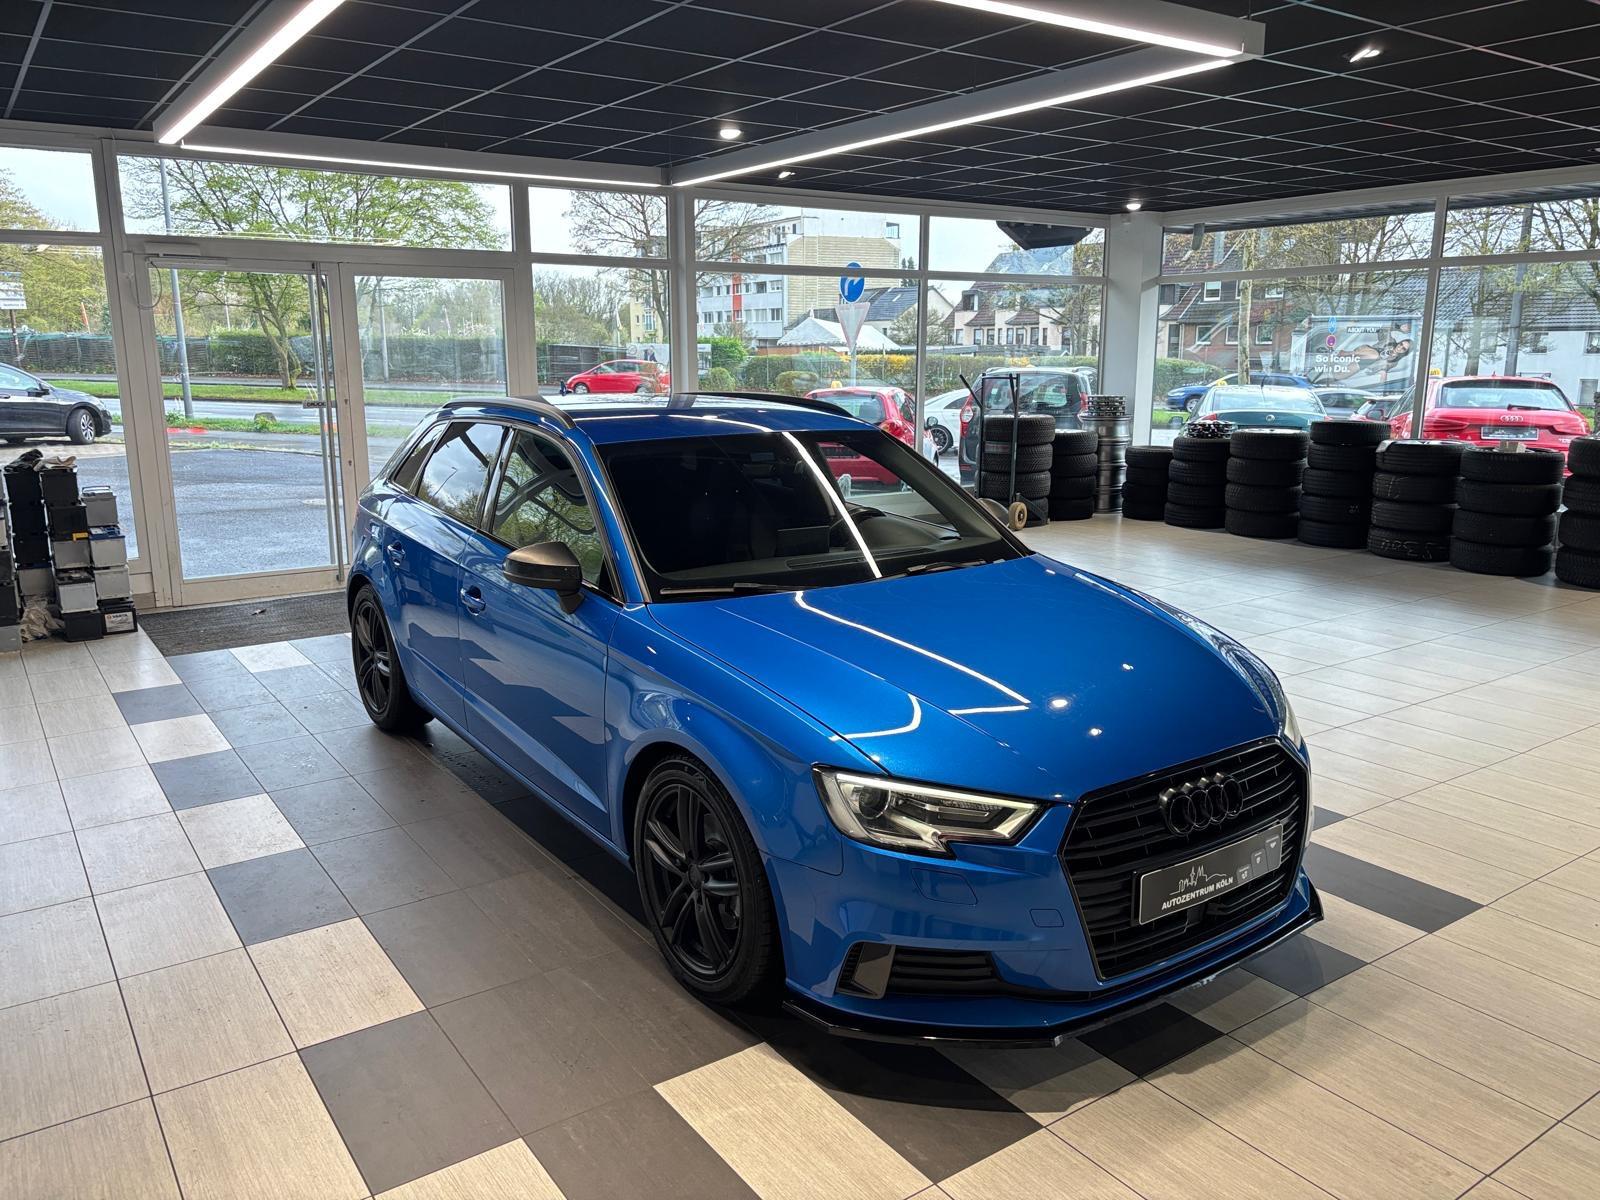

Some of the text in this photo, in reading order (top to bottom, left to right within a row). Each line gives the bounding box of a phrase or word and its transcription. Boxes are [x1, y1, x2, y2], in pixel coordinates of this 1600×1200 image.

[1315, 354, 1361, 362] So Iconic
[1334, 364, 1350, 372] Du.
[1161, 876, 1234, 910] AUTOZENTRUM KÖLN
